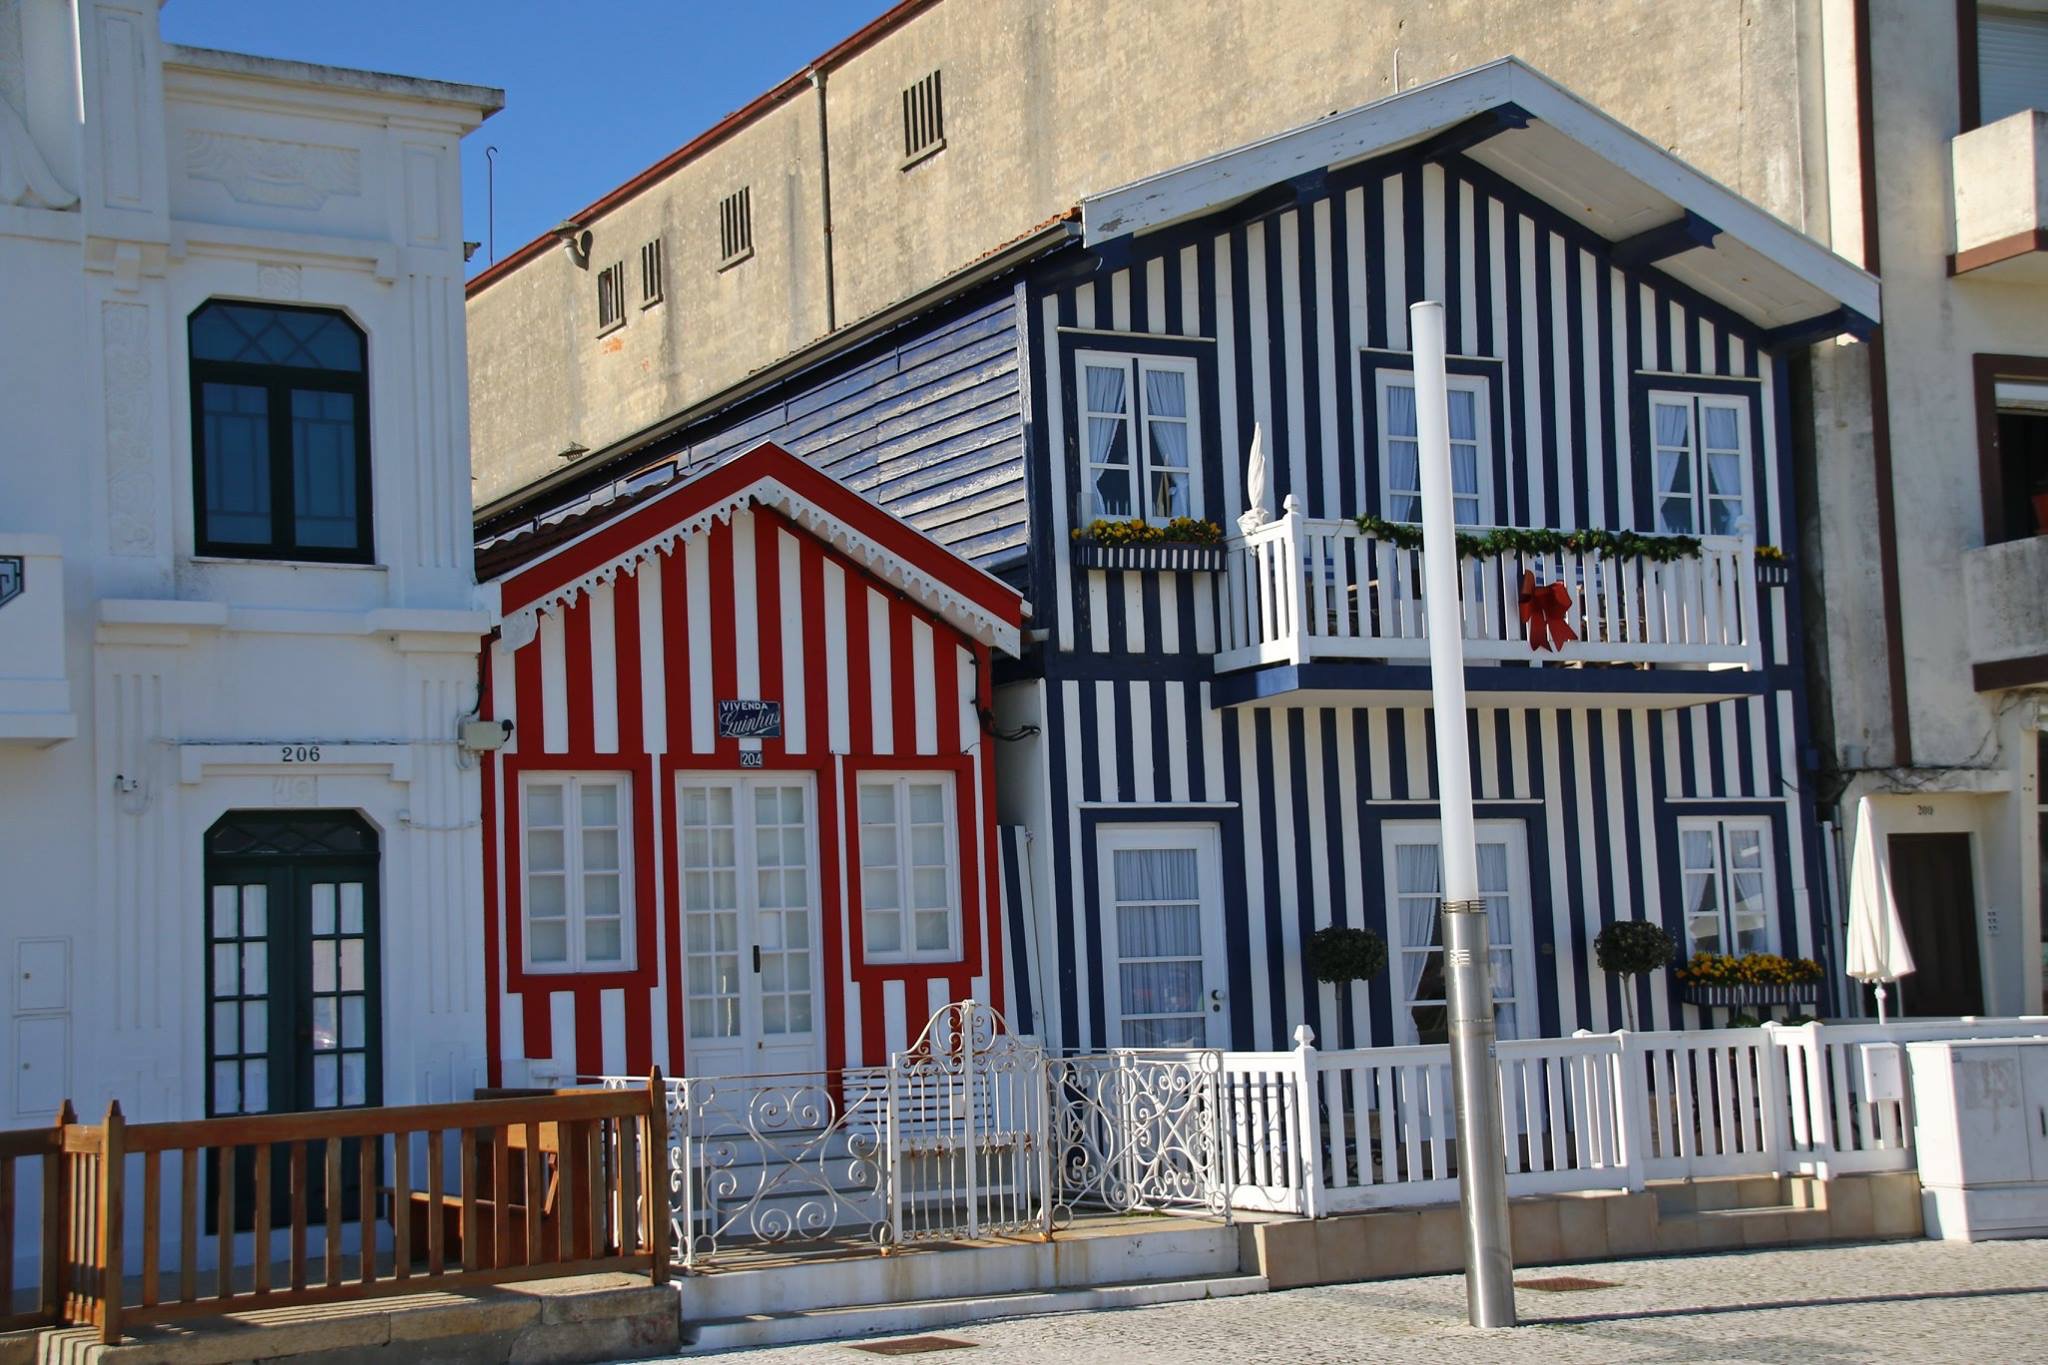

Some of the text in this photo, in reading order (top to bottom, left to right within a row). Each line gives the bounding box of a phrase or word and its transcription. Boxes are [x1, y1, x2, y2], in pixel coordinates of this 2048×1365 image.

[721, 702, 769, 711] VIVENDA
[281, 746, 321, 762] 206
[742, 752, 762, 766] 204
